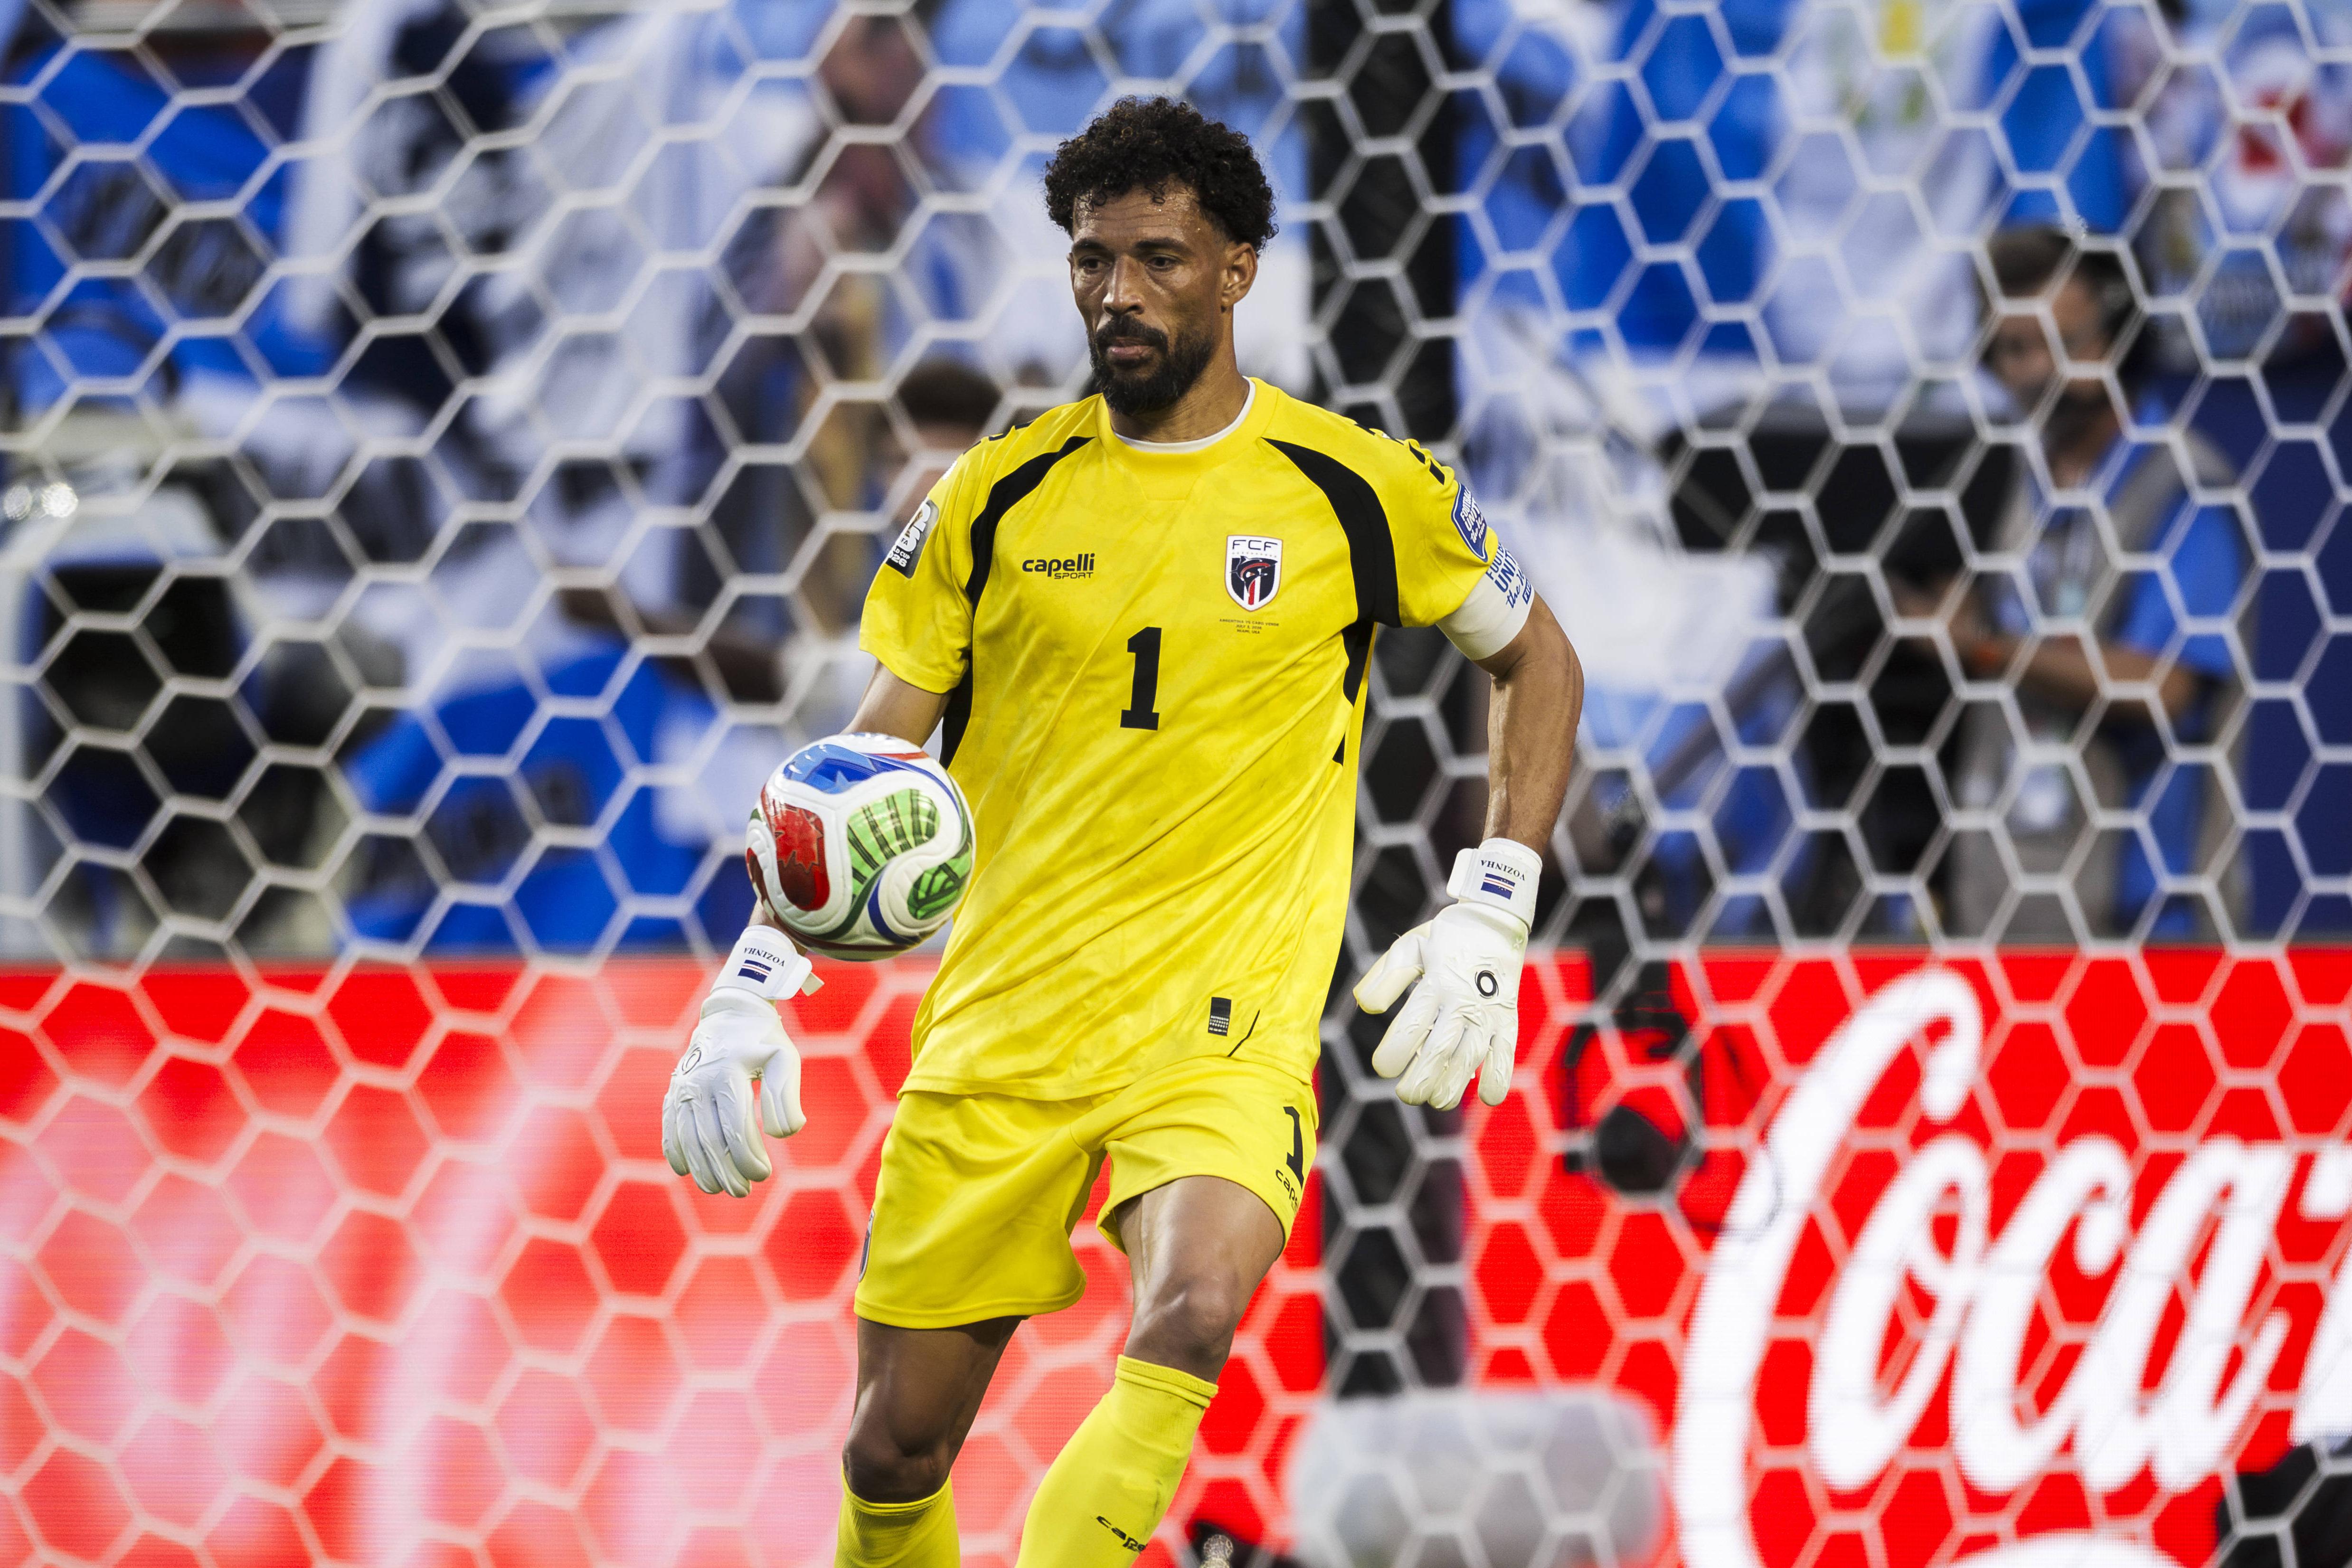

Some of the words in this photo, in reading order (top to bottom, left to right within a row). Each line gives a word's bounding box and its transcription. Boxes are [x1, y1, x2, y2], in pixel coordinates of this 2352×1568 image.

[1465, 497, 1480, 531] UNIT
[900, 551, 910, 559] CUP
[1232, 539, 1278, 551] FCF
[888, 551, 907, 567] 026
[1022, 553, 1095, 577] capelli
[1494, 548, 1516, 593] UNIT
[1120, 627, 1162, 730] 1
[1481, 860, 1525, 881] VOZINHA
[744, 947, 785, 967] VOZINHA
[1283, 1106, 1304, 1190] 1
[1672, 966, 2352, 1568] Coca
